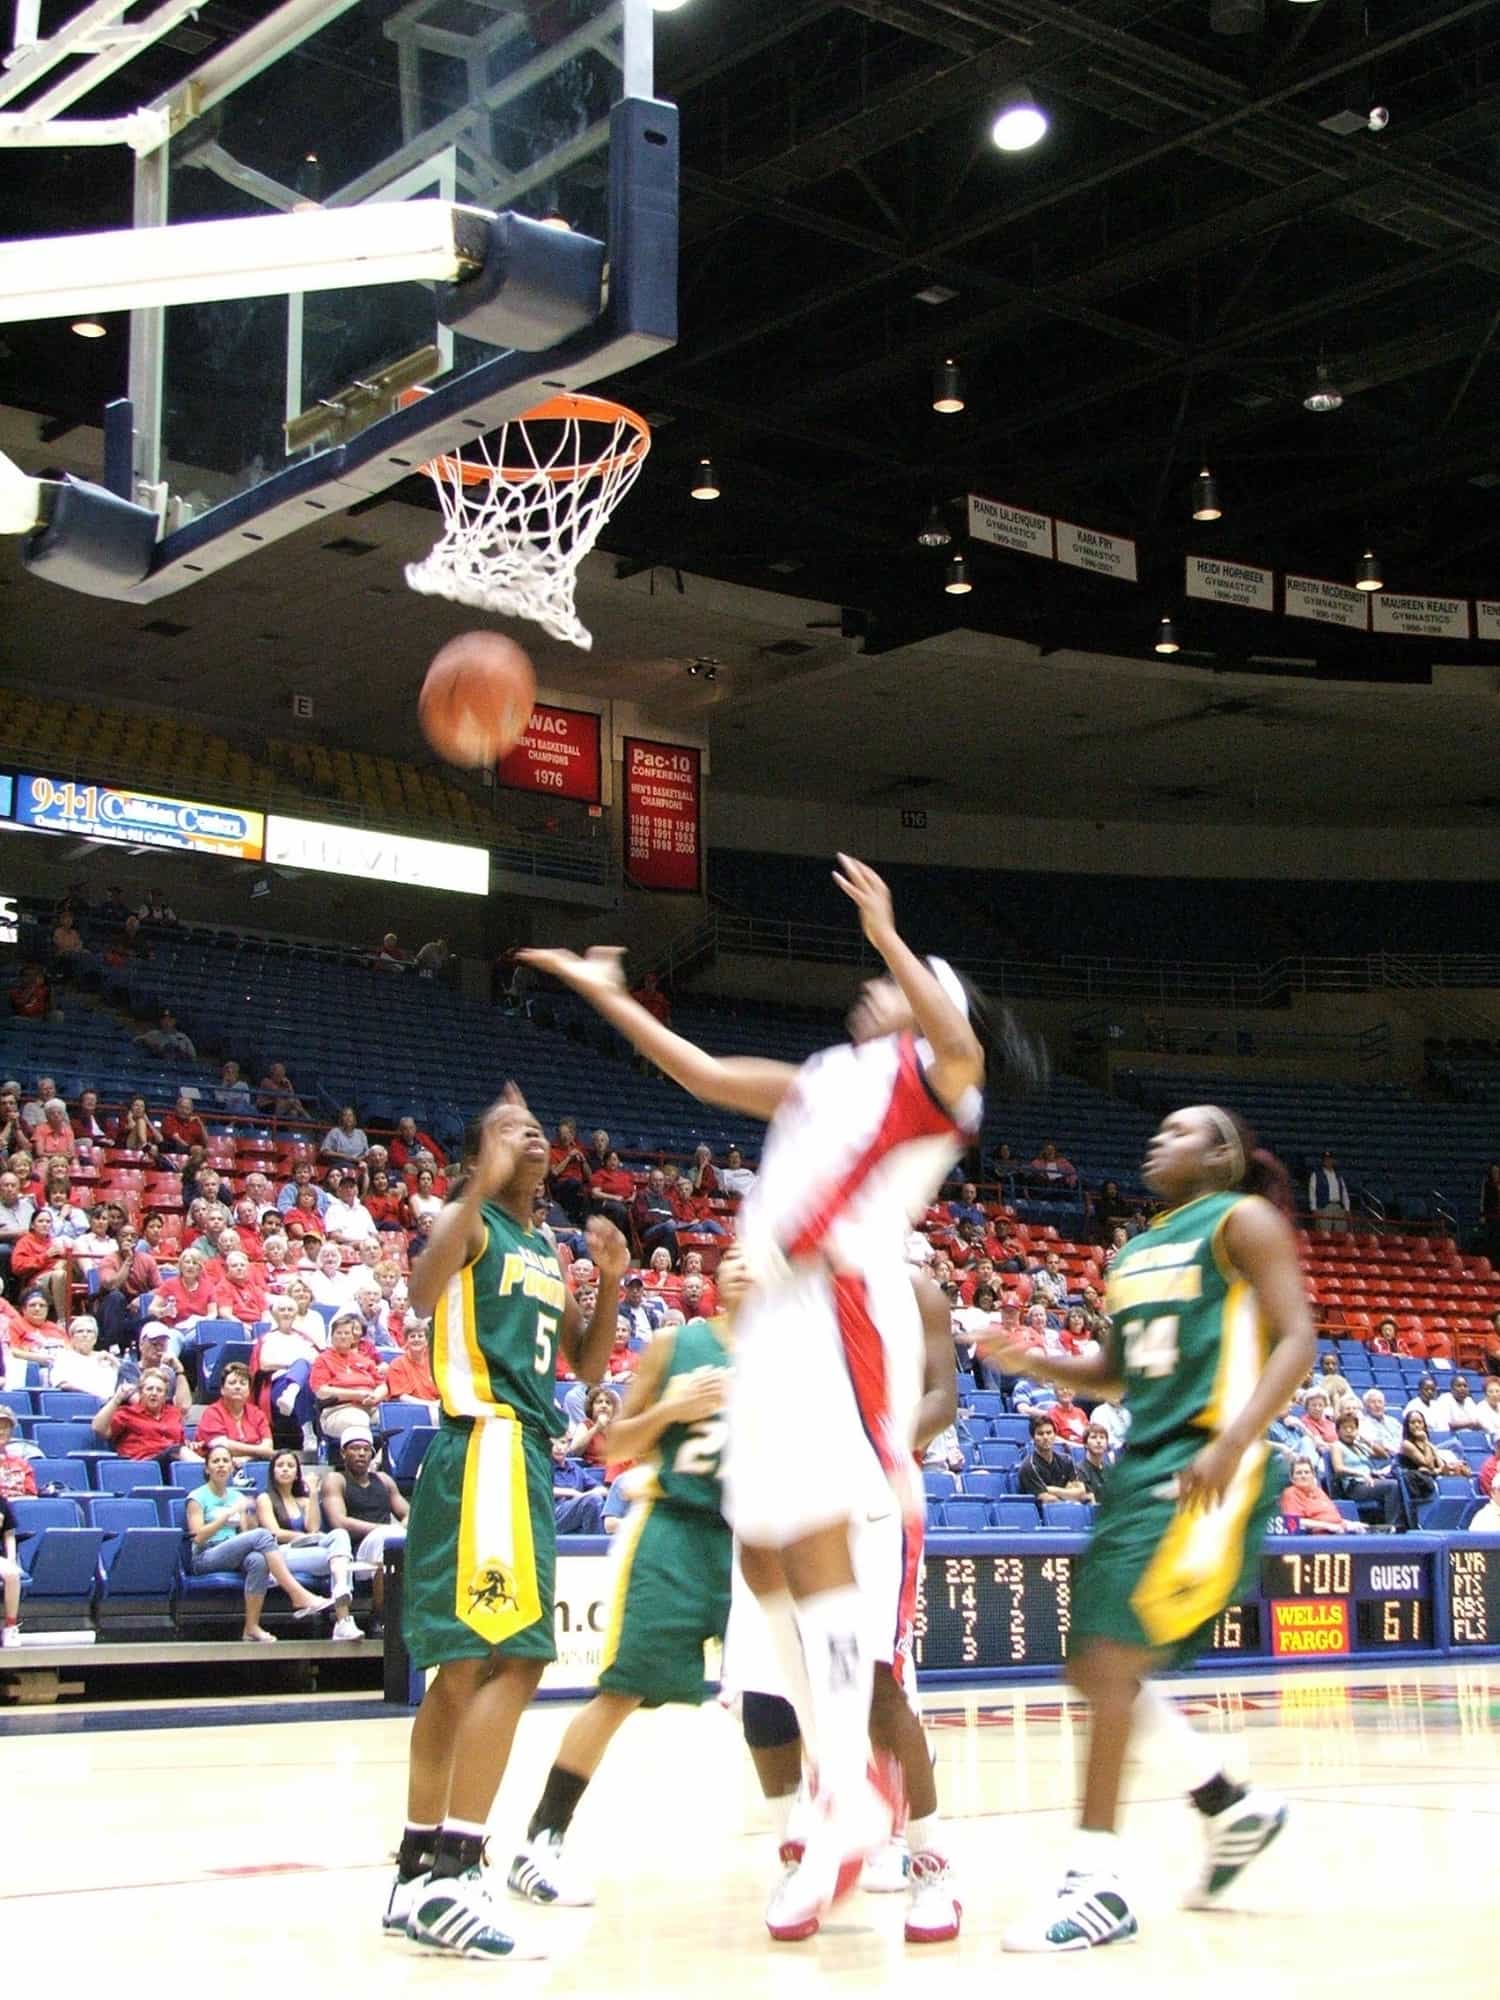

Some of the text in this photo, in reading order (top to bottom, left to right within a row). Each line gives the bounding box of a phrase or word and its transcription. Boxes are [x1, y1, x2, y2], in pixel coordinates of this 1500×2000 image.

[974, 500, 998, 519] RANDI
[985, 518, 1036, 540] GYMNASTICS
[1077, 530, 1113, 550] KARA FRY
[1072, 543, 1121, 564] GYMNASTICS
[1197, 560, 1220, 575] HEIDI
[1204, 577, 1257, 594] GYMNASTICS
[1288, 579, 1319, 594] KRISTIN
[1304, 597, 1353, 613] GYMNASTICS
[1381, 597, 1424, 610] MAUREEN
[1392, 611, 1450, 624] GYMNASTICS
[528, 714, 568, 736] WAC
[528, 750, 569, 766] CHAMPIONS
[537, 739, 580, 757] BASKETBALL
[534, 769, 563, 787] 1976
[632, 766, 692, 783] CONFERENCE
[631, 783, 694, 801] MEN'S BASKETBALL
[641, 796, 683, 811] CHAMPIONS
[675, 842, 696, 854] 2000
[535, 1311, 558, 1375] 5
[946, 1559, 976, 1583] 22
[994, 1559, 1024, 1583] 23
[1041, 1558, 1070, 1583] 45
[1283, 1553, 1350, 1595] 7:00
[1370, 1565, 1420, 1591] GUEST
[1454, 1574, 1482, 1596] PTS
[949, 1585, 977, 1609] 14
[1009, 1584, 1024, 1608] 7
[1056, 1583, 1071, 1607] 8
[913, 1608, 1071, 1637] 3 7 2 3
[1276, 1605, 1344, 1627] WELLS
[1382, 1600, 1420, 1642] 61
[1454, 1618, 1487, 1641] FLS
[916, 1633, 1067, 1664] 1 3 3 1
[1279, 1630, 1344, 1652] FARGO
